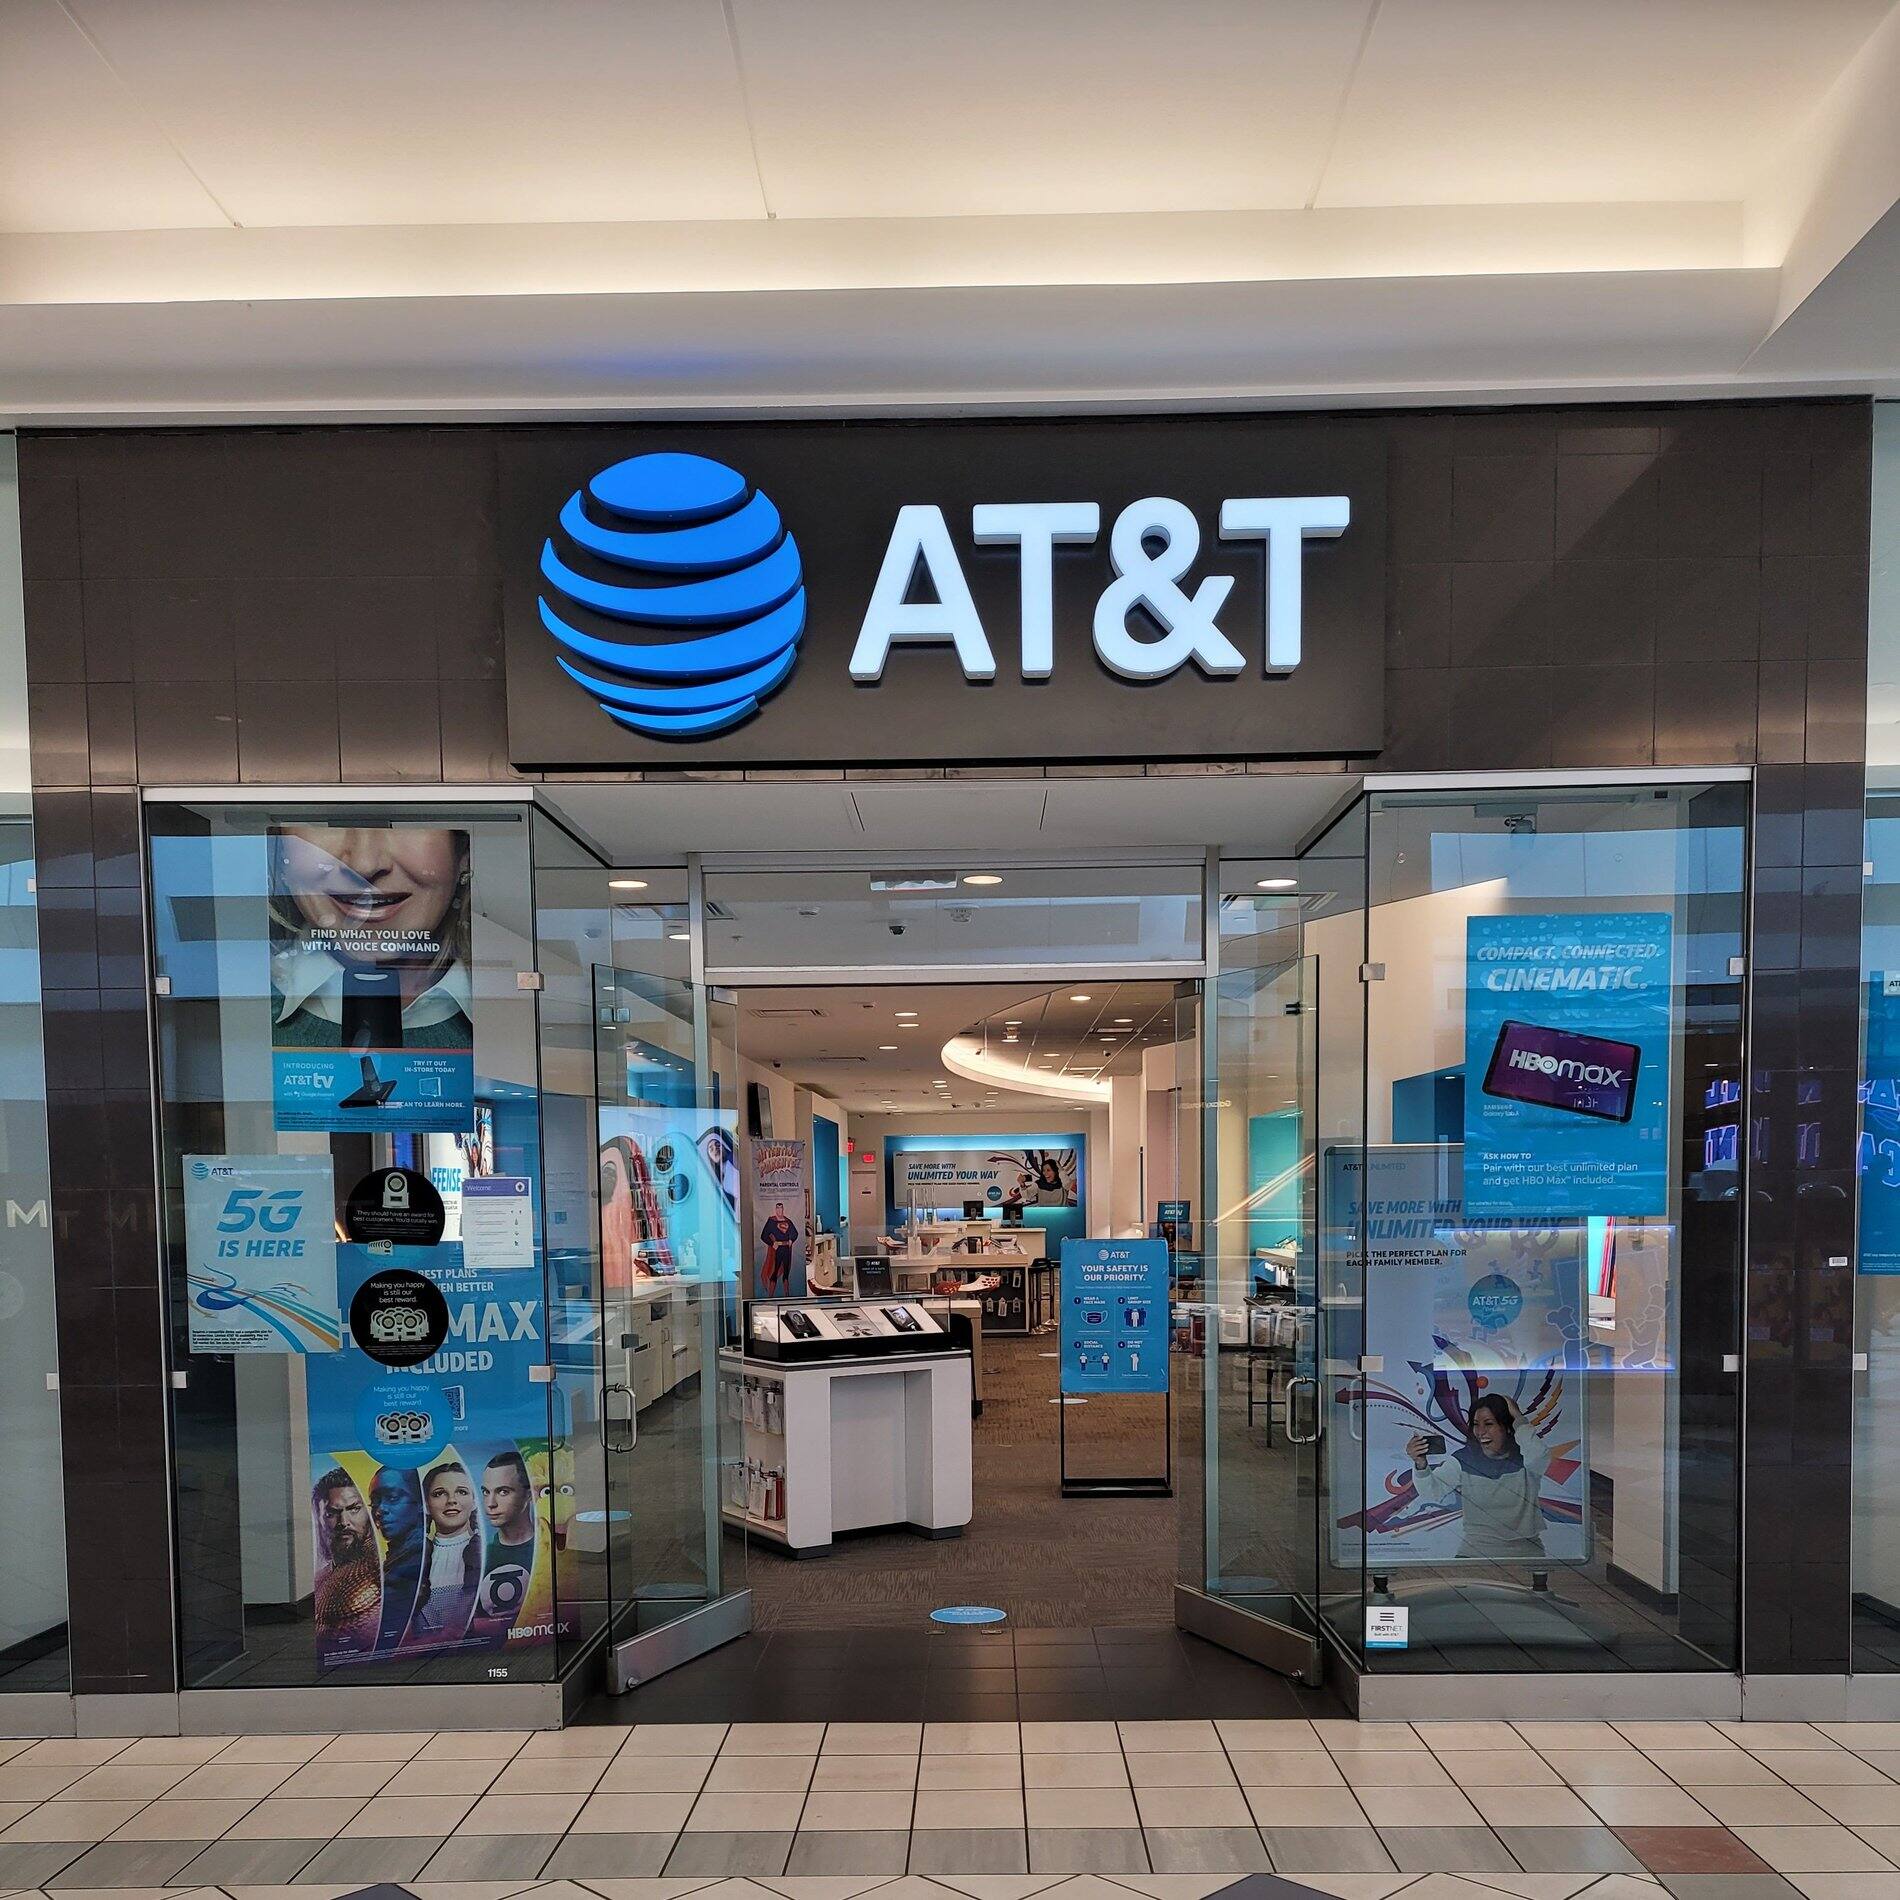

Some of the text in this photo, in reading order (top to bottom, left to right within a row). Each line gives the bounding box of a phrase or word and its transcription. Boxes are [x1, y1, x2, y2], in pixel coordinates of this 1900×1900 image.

[848, 495, 1351, 683] AT&T
[311, 929, 430, 940] FIND WHAT YOU LOVE
[301, 941, 440, 952] WITH A VOICE COMMAND
[1476, 944, 1659, 960] COMPACT. CONNECTED.
[1486, 966, 1648, 992] CINEMATIC.
[284, 1075, 312, 1086] AT&T
[1483, 1162, 1638, 1173] Pair with our best unlimited plan
[908, 1170, 999, 1180] UNLIMITED YOUR WAY
[1483, 1176, 1500, 1186] and
[1504, 1177, 1520, 1187] get
[1522, 1176, 1543, 1184] HBO
[1573, 1175, 1616, 1184] included.
[217, 1190, 304, 1233] 5G
[1387, 1200, 1426, 1214] MORE
[1428, 1200, 1463, 1213] WITH
[218, 1240, 305, 1257] IS HERE
[1110, 1251, 1130, 1259] AT&T
[446, 1269, 478, 1278] PLANS
[456, 1282, 494, 1292] BETTER
[1472, 1295, 1519, 1305] AT&T 5G
[488, 1668, 508, 1678] 1155
